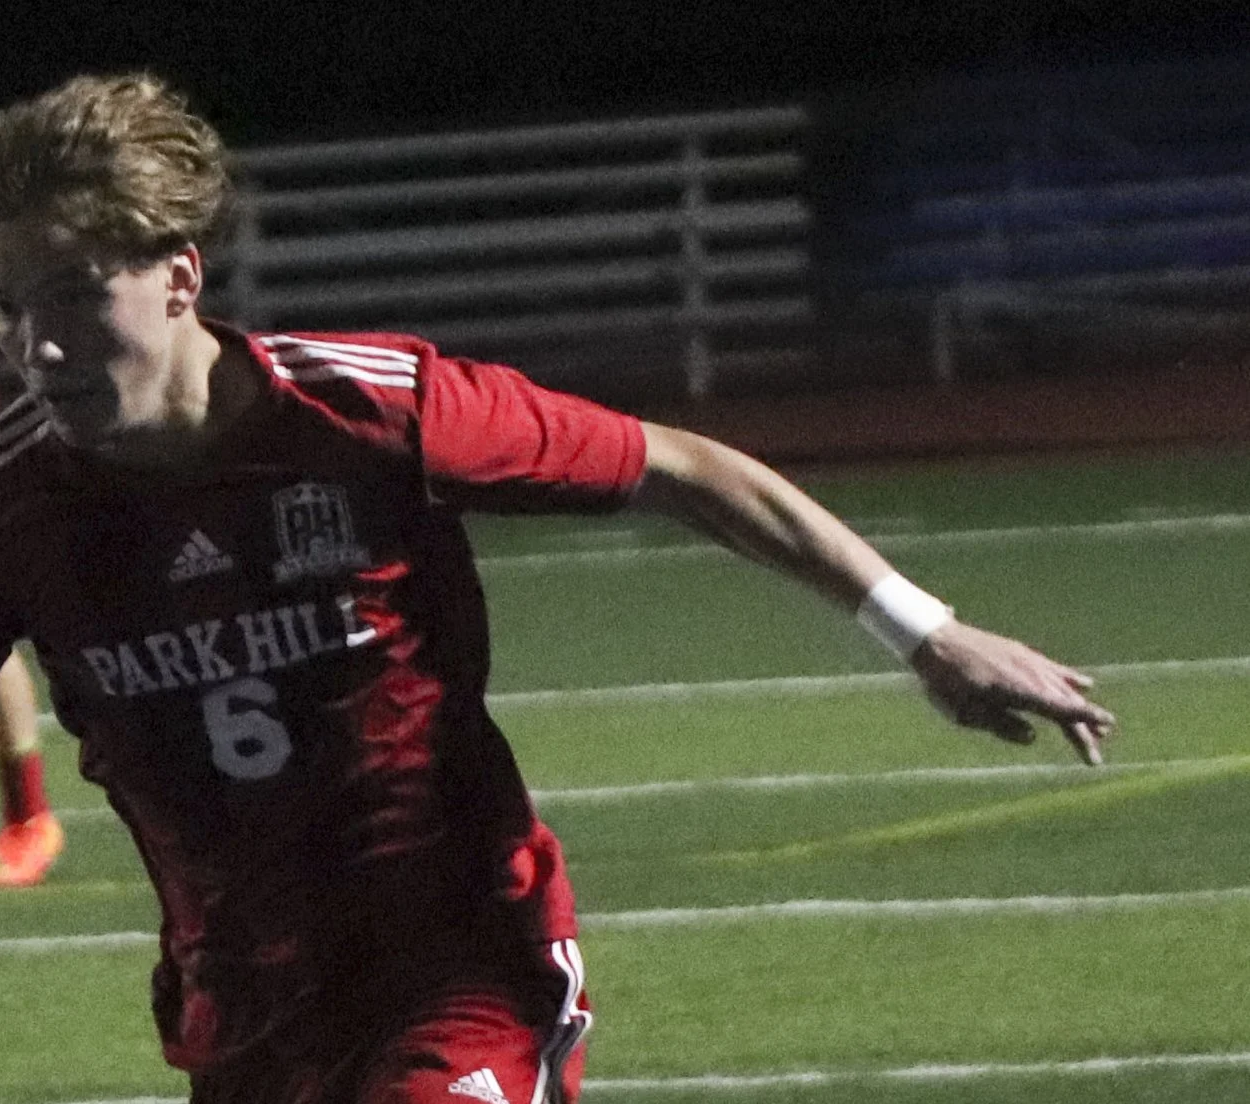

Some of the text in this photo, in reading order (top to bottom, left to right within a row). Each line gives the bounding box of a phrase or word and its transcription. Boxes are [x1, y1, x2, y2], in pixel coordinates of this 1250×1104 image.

[81, 593, 377, 697] PARK HILL
[202, 676, 293, 781] 6
